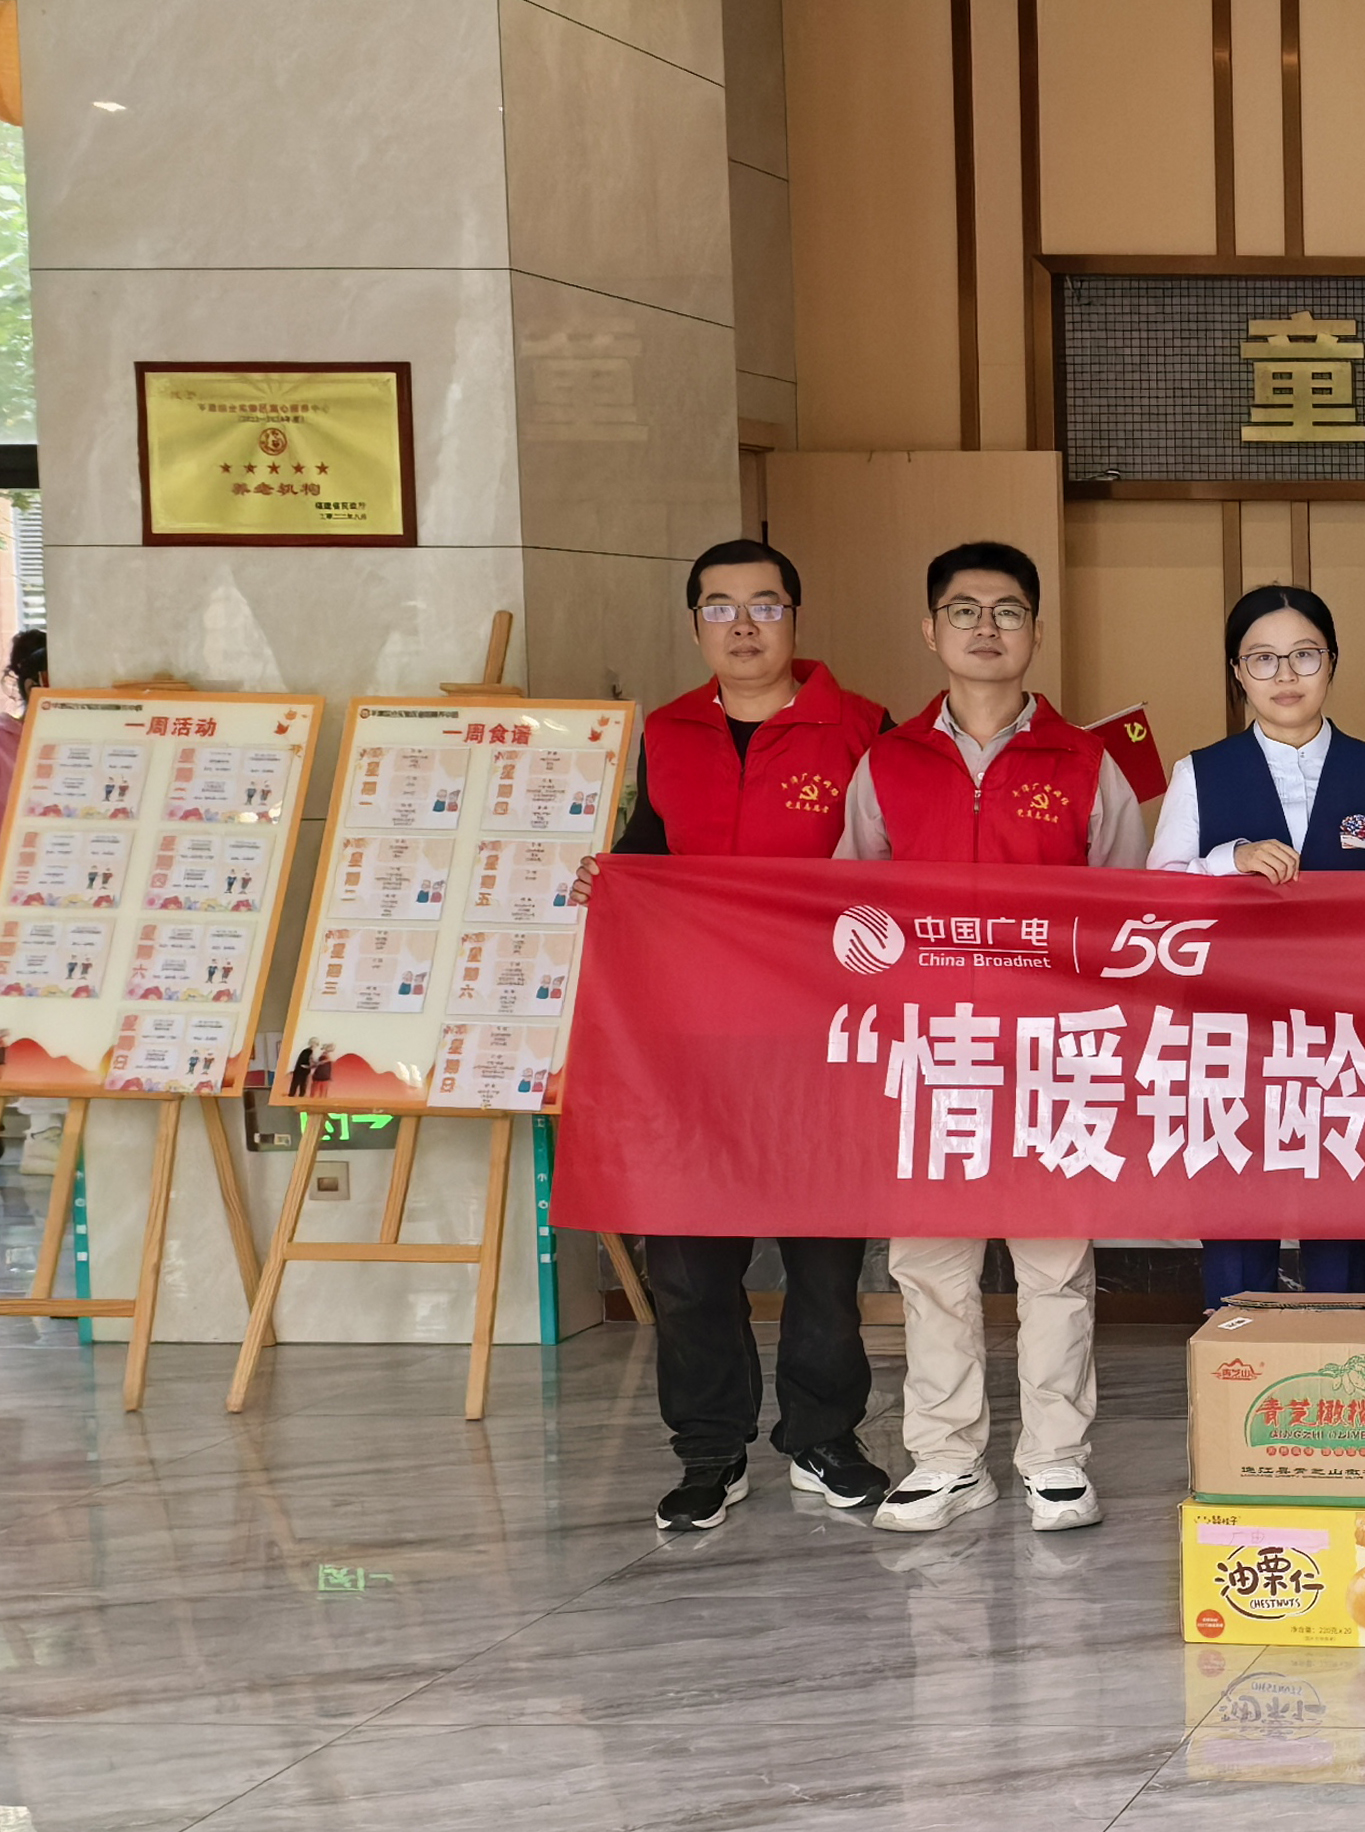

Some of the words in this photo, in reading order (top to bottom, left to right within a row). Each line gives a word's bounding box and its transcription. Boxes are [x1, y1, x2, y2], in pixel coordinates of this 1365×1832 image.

[125, 715, 217, 738] 一周活动
[442, 722, 532, 745] 一周食谱
[914, 916, 1050, 946] 中国广电
[1101, 913, 1219, 978] 5G
[918, 953, 965, 967] China
[973, 953, 1051, 968] Broadnet
[1214, 1547, 1324, 1596] 油栗仁
[1250, 1598, 1301, 1609] CHESTNUTS
